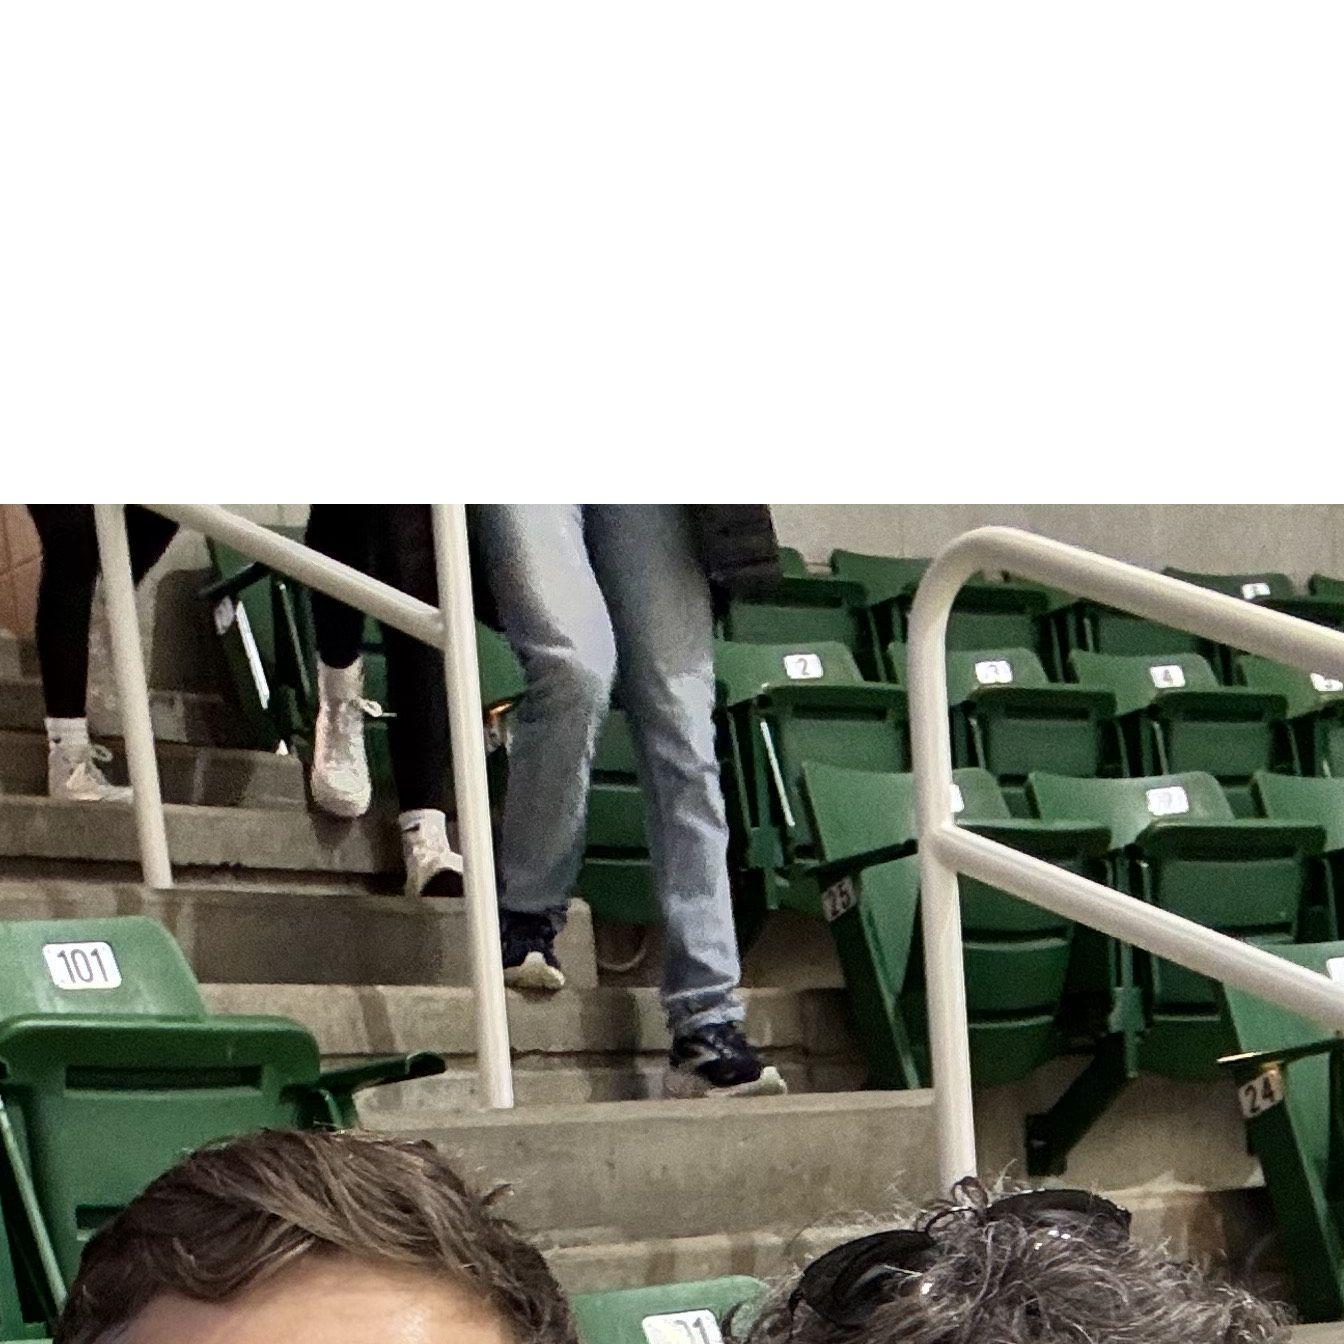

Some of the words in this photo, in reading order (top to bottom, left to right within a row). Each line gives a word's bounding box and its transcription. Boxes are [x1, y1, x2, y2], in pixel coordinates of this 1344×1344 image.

[796, 657, 810, 677] 2
[1161, 668, 1174, 686] 4
[55, 949, 110, 986] 101
[1243, 1074, 1276, 1114] 24
